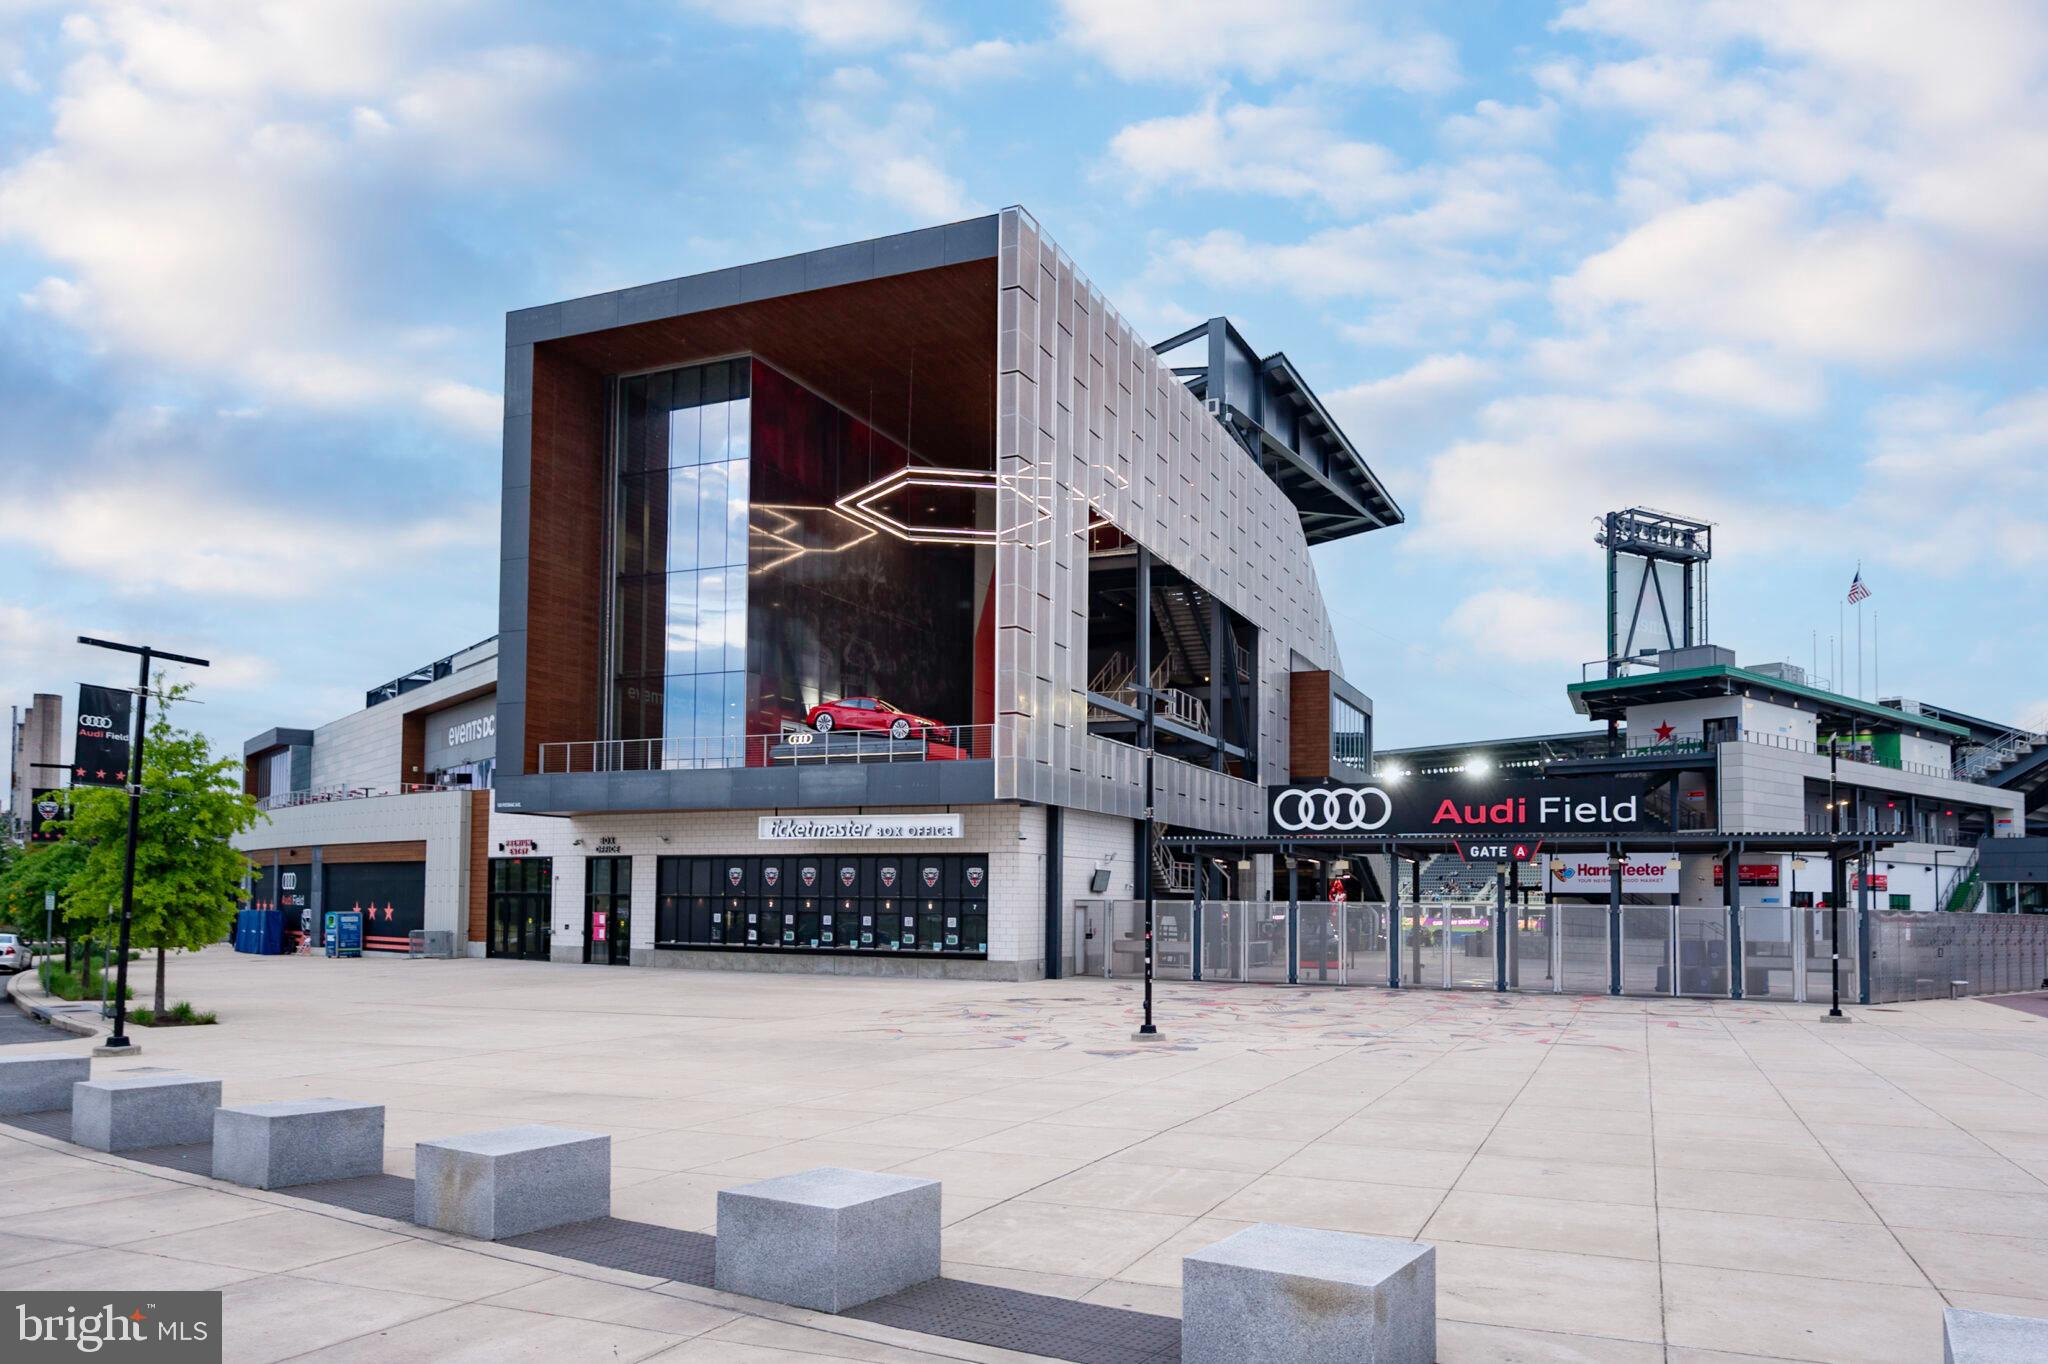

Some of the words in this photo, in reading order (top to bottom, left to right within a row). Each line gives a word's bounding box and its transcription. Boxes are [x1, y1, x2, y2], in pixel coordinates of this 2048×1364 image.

[80, 729, 104, 738] Audi
[105, 731, 130, 741] Field
[1432, 797, 1526, 824] Audi
[1539, 795, 1637, 823] Field
[771, 818, 872, 838] ticketmaster
[876, 826, 902, 837] BOX
[908, 826, 953, 837] OFFICE
[1470, 846, 1508, 858] GATE
[1515, 846, 1525, 857] A
[1577, 863, 1611, 877] Harri
[1621, 863, 1667, 876] Teeter
